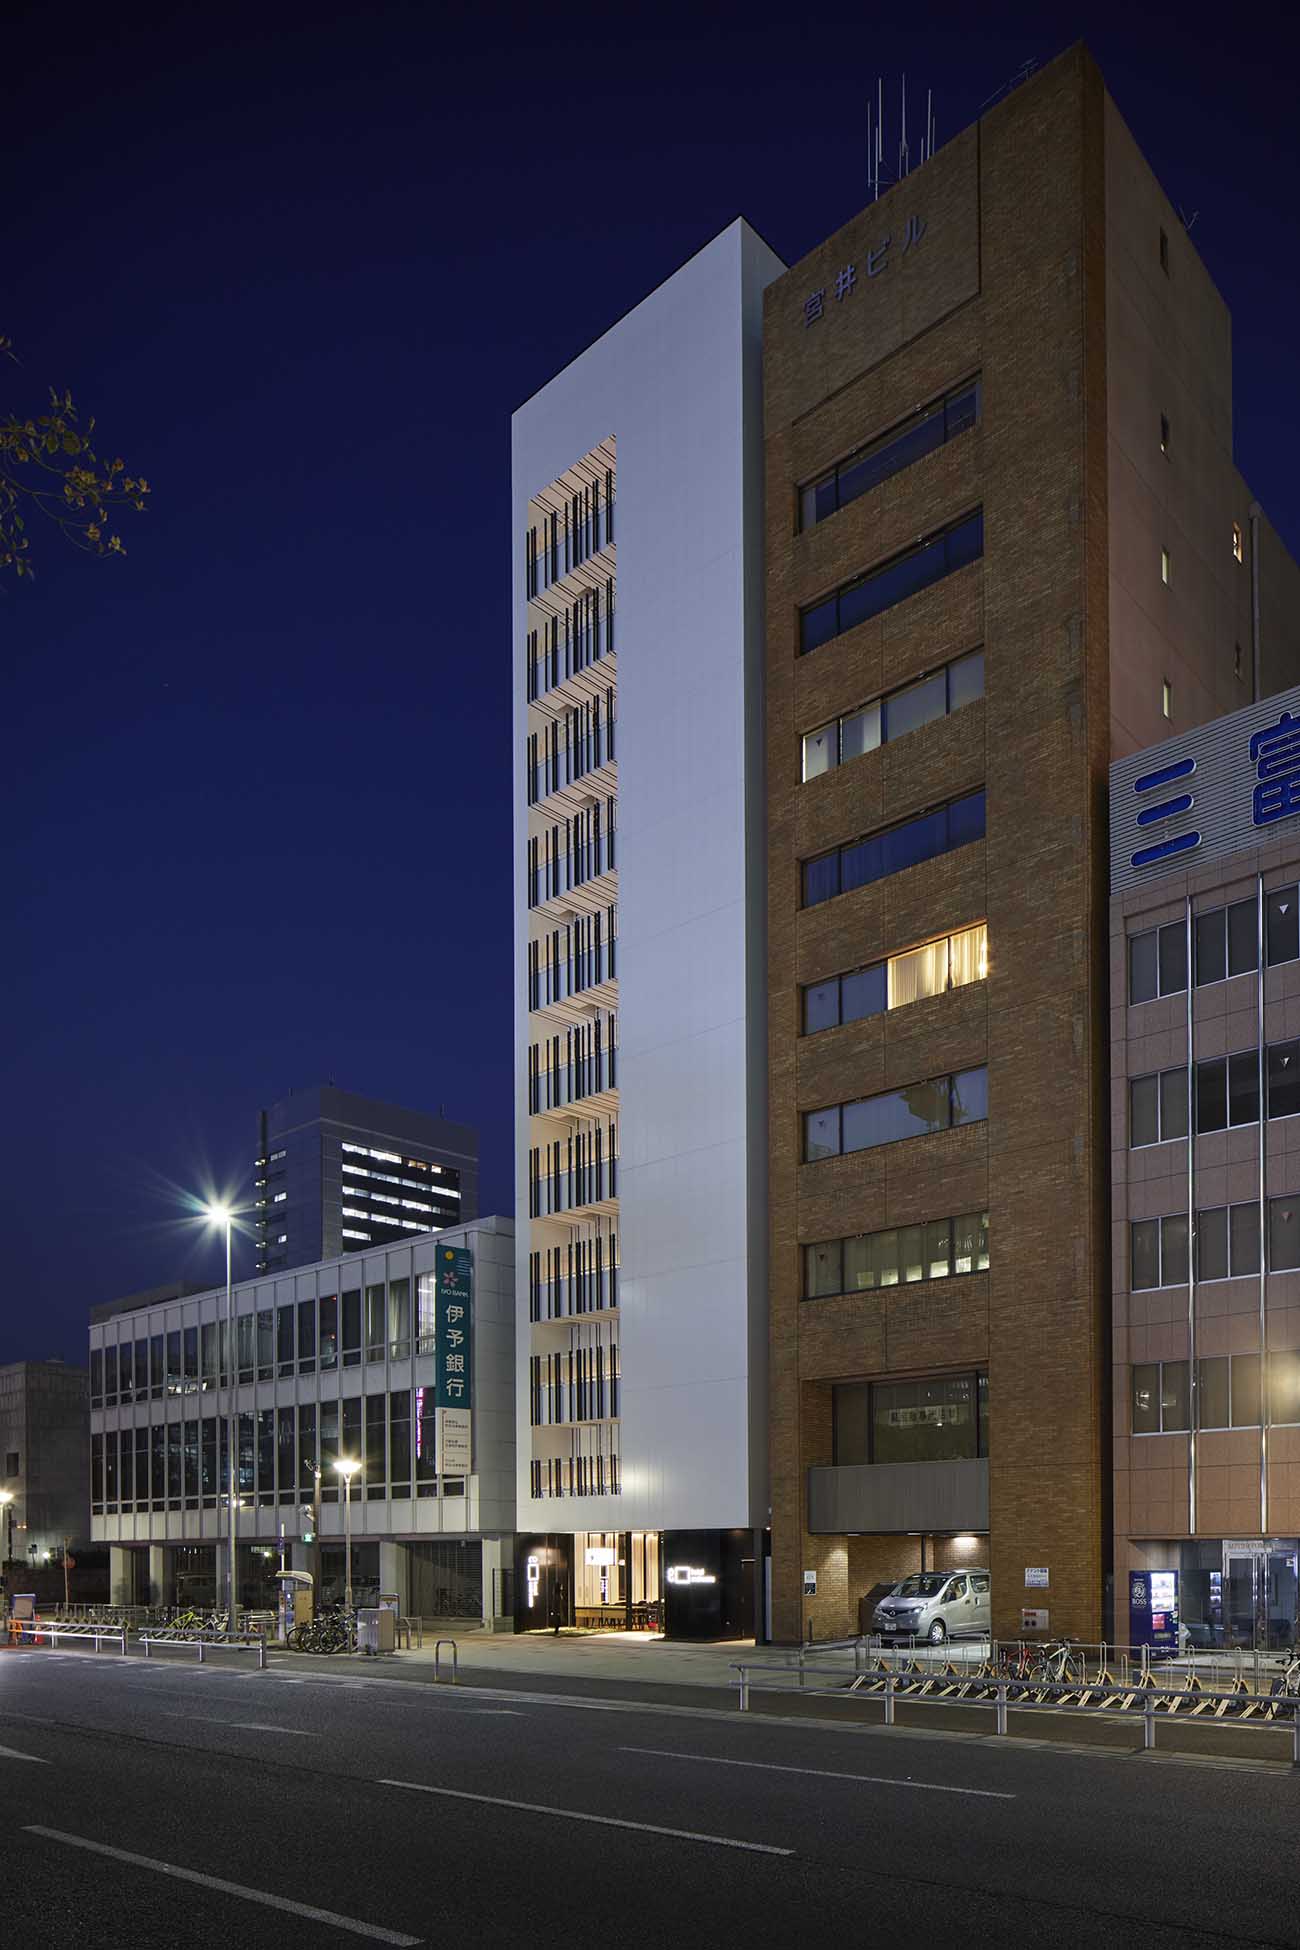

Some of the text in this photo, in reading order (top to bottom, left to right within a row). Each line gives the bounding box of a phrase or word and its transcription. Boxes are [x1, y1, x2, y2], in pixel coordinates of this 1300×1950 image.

[445, 1304, 465, 1398] 伊予銀行
[1132, 1597, 1147, 1605] BOSS
